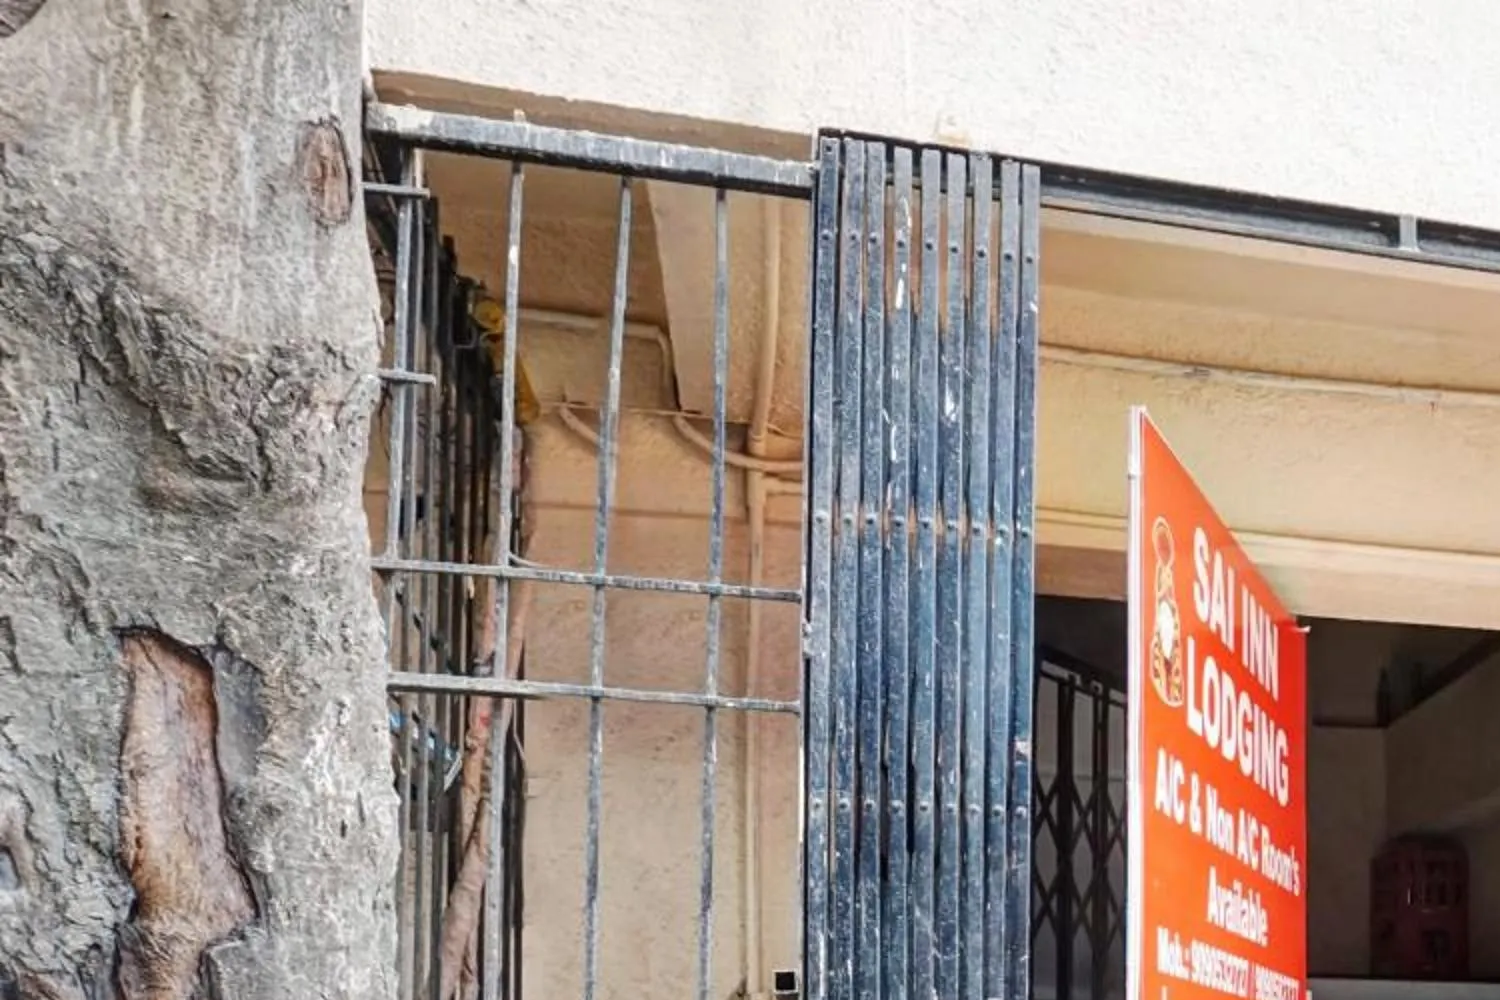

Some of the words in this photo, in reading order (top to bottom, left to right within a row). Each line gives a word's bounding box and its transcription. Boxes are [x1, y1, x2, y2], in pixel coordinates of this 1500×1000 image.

[1193, 527, 1234, 652] SAI
[1242, 585, 1278, 701] INN
[1187, 636, 1288, 807] LODGING
[1189, 772, 1201, 835] &
[1206, 784, 1234, 856] Non
[1207, 866, 1268, 947] Available
